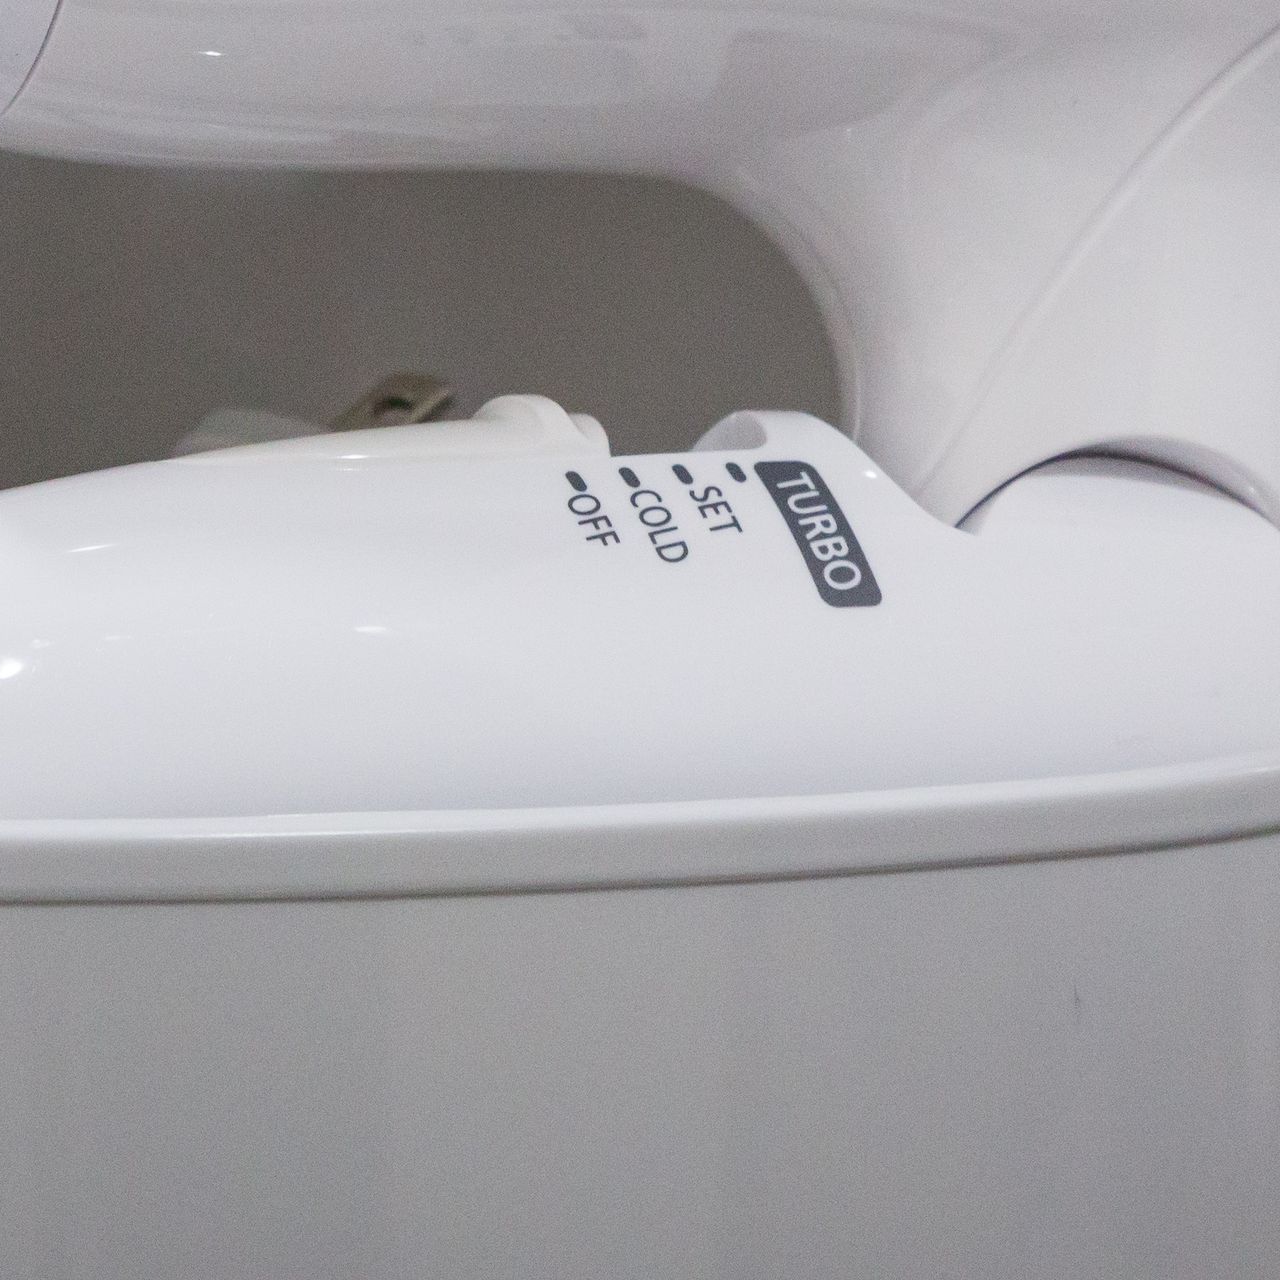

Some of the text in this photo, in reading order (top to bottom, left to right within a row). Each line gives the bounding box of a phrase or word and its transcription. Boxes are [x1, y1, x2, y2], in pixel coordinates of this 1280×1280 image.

[567, 493, 621, 546] OFF
[630, 489, 689, 563] COLD
[689, 485, 743, 534] SET
[776, 472, 862, 590] TURBO
